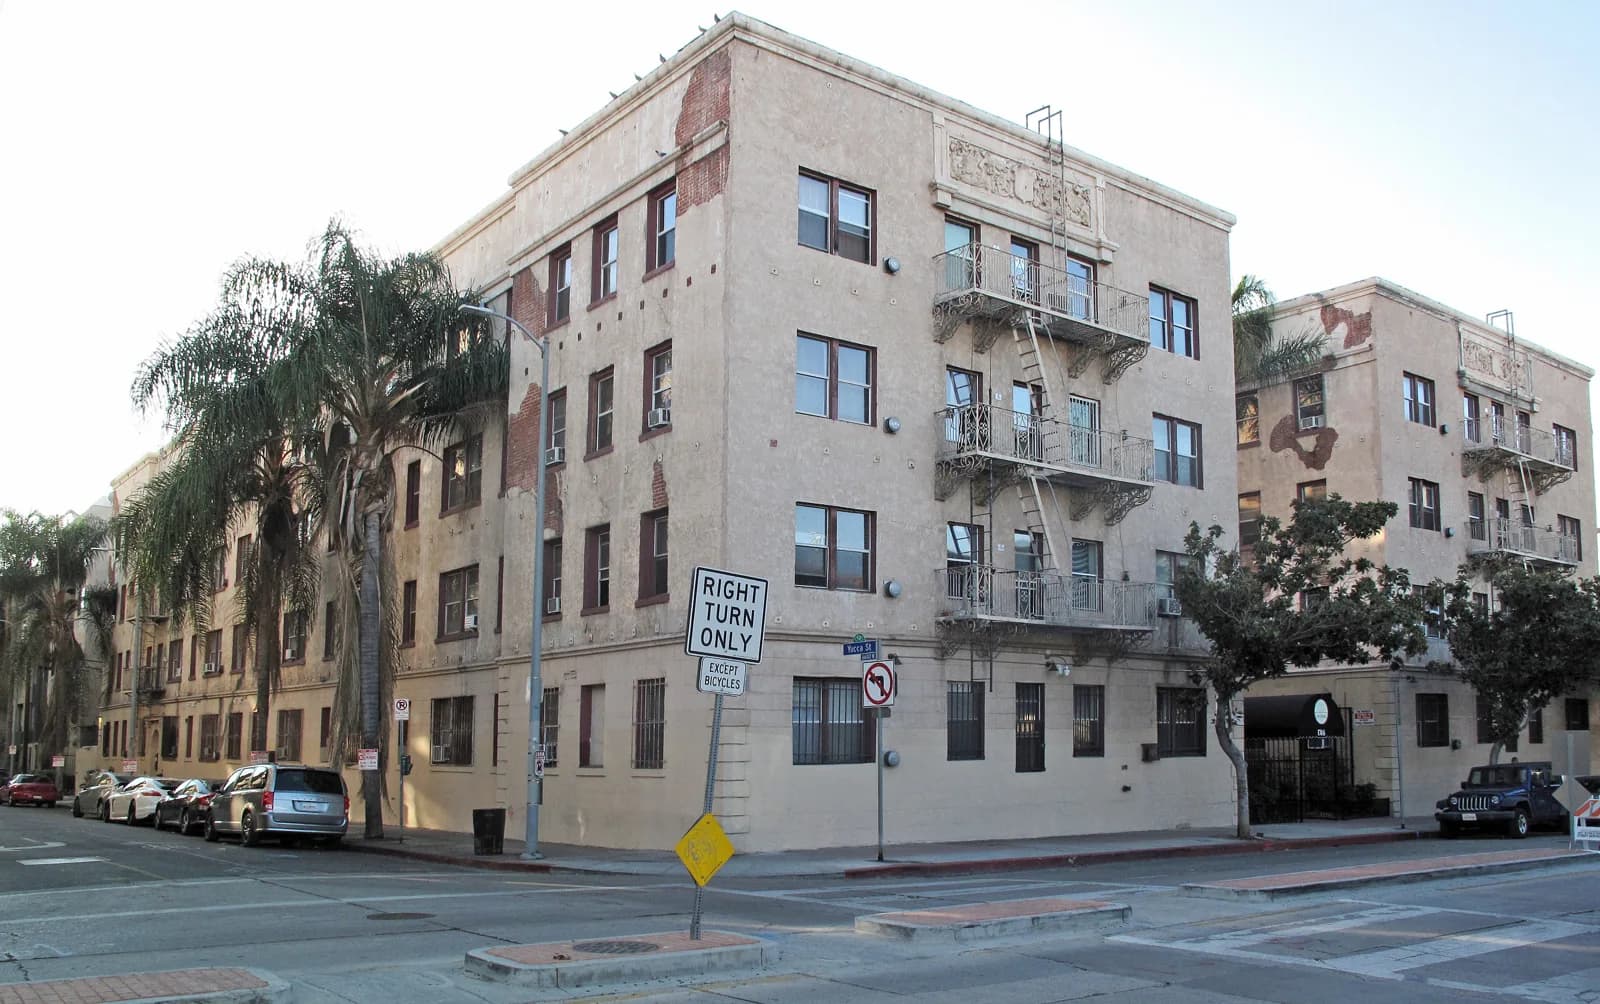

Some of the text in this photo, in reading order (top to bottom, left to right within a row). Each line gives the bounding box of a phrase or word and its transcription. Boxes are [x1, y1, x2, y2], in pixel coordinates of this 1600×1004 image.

[703, 576, 760, 604] RIGHT
[705, 601, 755, 628] TURN
[701, 627, 753, 653] ONLY
[847, 642, 872, 653] Yucca St
[709, 662, 739, 676] EXCEPT
[704, 675, 741, 690] BICYCLES
